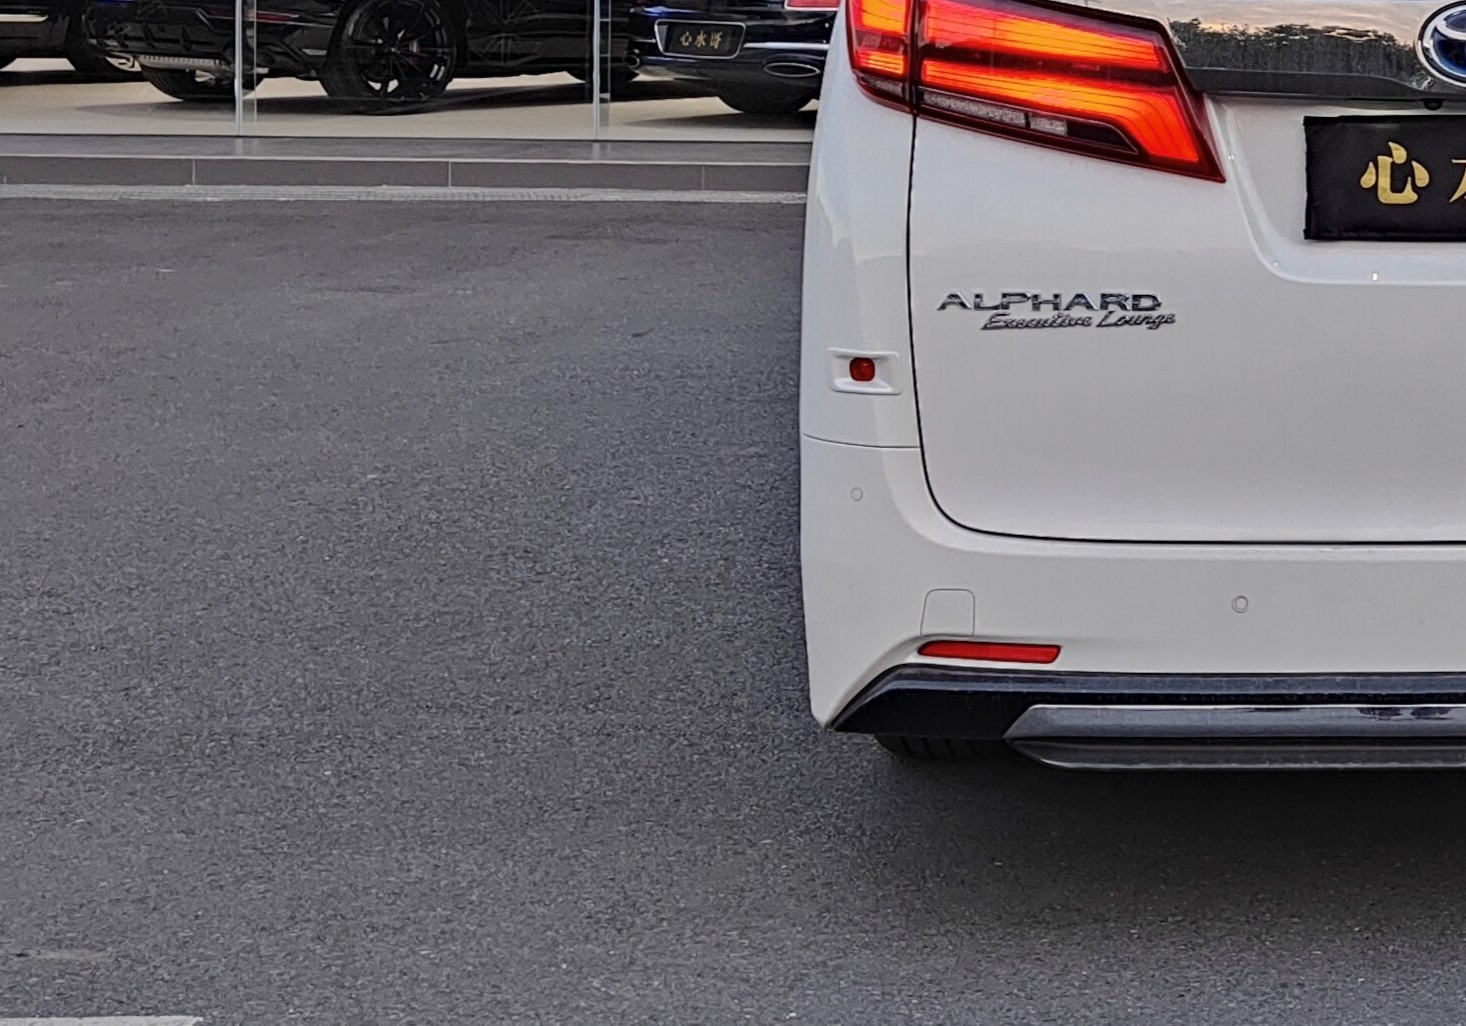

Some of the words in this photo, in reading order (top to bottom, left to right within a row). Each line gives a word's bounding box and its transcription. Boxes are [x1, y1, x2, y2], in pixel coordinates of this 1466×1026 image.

[680, 31, 723, 49] 心水哥
[937, 292, 1162, 312] ALPHARD
[980, 313, 1093, 331] Executive
[1096, 311, 1176, 330] Lounge
